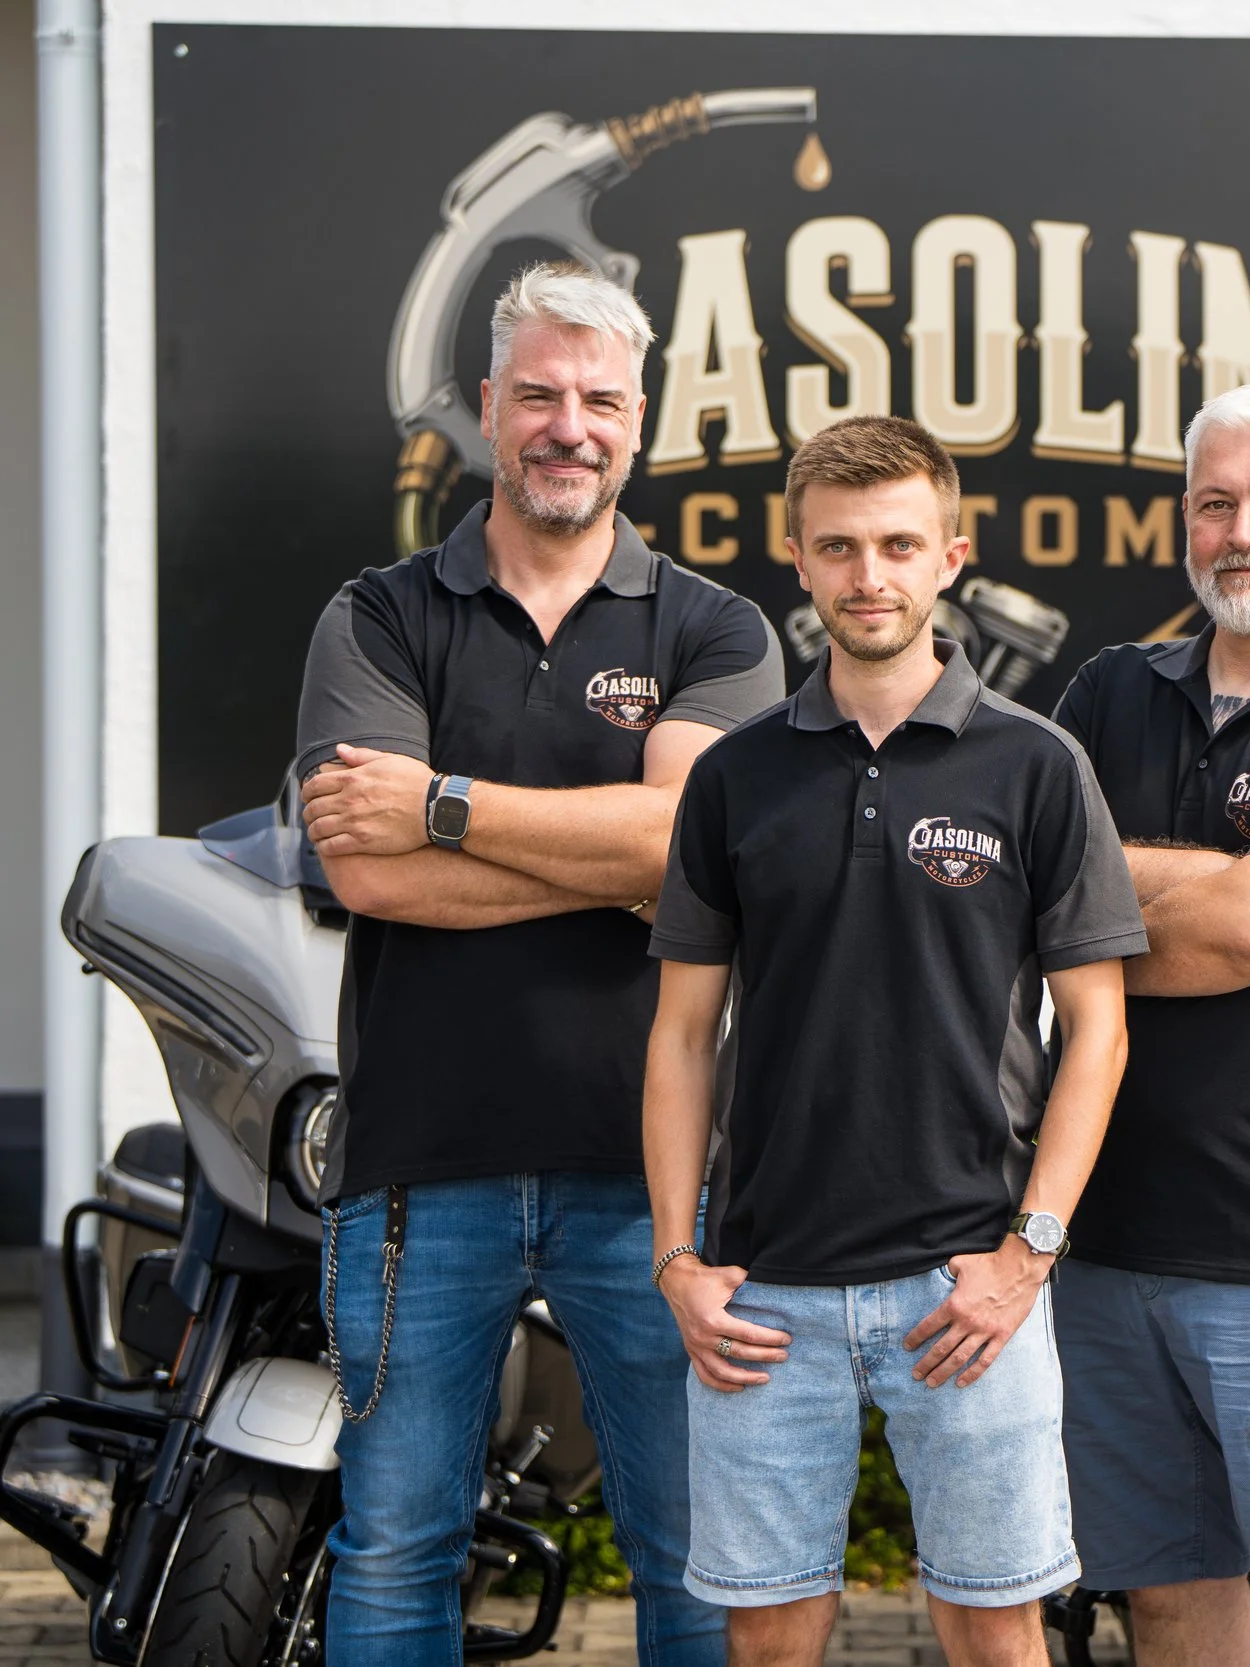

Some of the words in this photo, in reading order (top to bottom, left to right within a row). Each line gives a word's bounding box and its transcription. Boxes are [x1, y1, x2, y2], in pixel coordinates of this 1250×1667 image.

[681, 492, 1177, 567] CTOM
[610, 697, 654, 706] CUSTOM
[908, 817, 1001, 863] GASOLINA
[933, 850, 980, 862] CUSTOM
[927, 865, 982, 884] MOTORCYCLES
